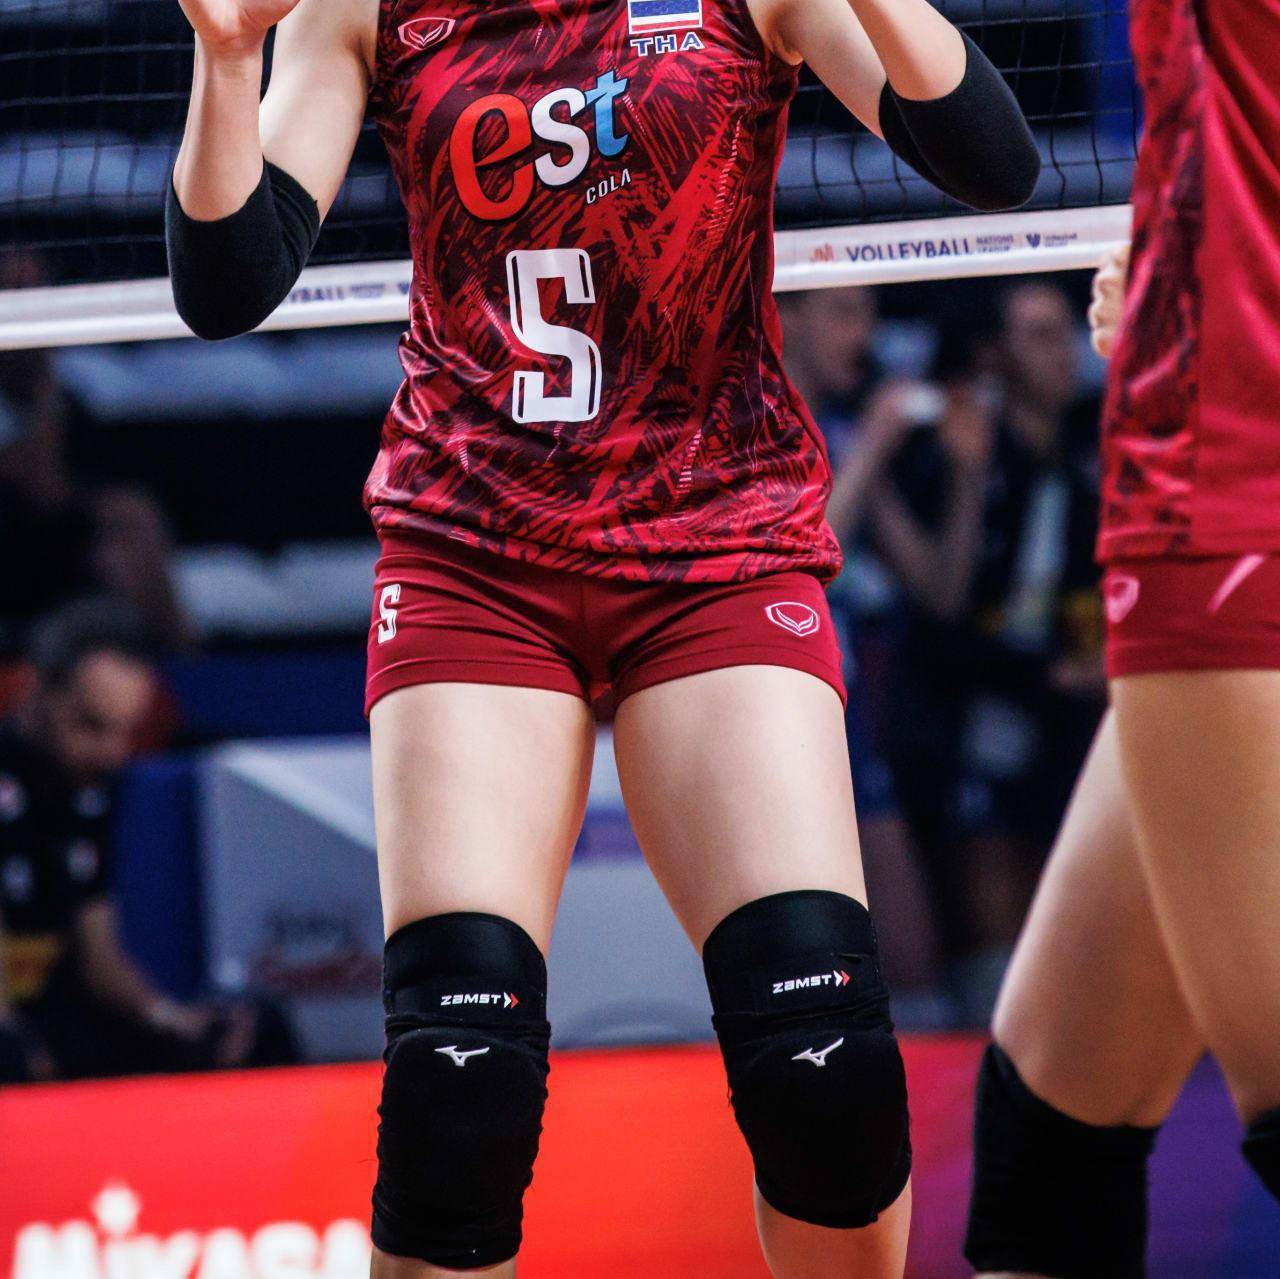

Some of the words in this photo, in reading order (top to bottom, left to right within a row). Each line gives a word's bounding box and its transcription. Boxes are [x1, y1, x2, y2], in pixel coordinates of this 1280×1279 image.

[629, 31, 705, 57] THA
[449, 70, 630, 222] est
[585, 167, 632, 205] COLA
[846, 237, 971, 262] VOLLEYBALL
[505, 248, 602, 424] 5
[378, 584, 401, 644] 5
